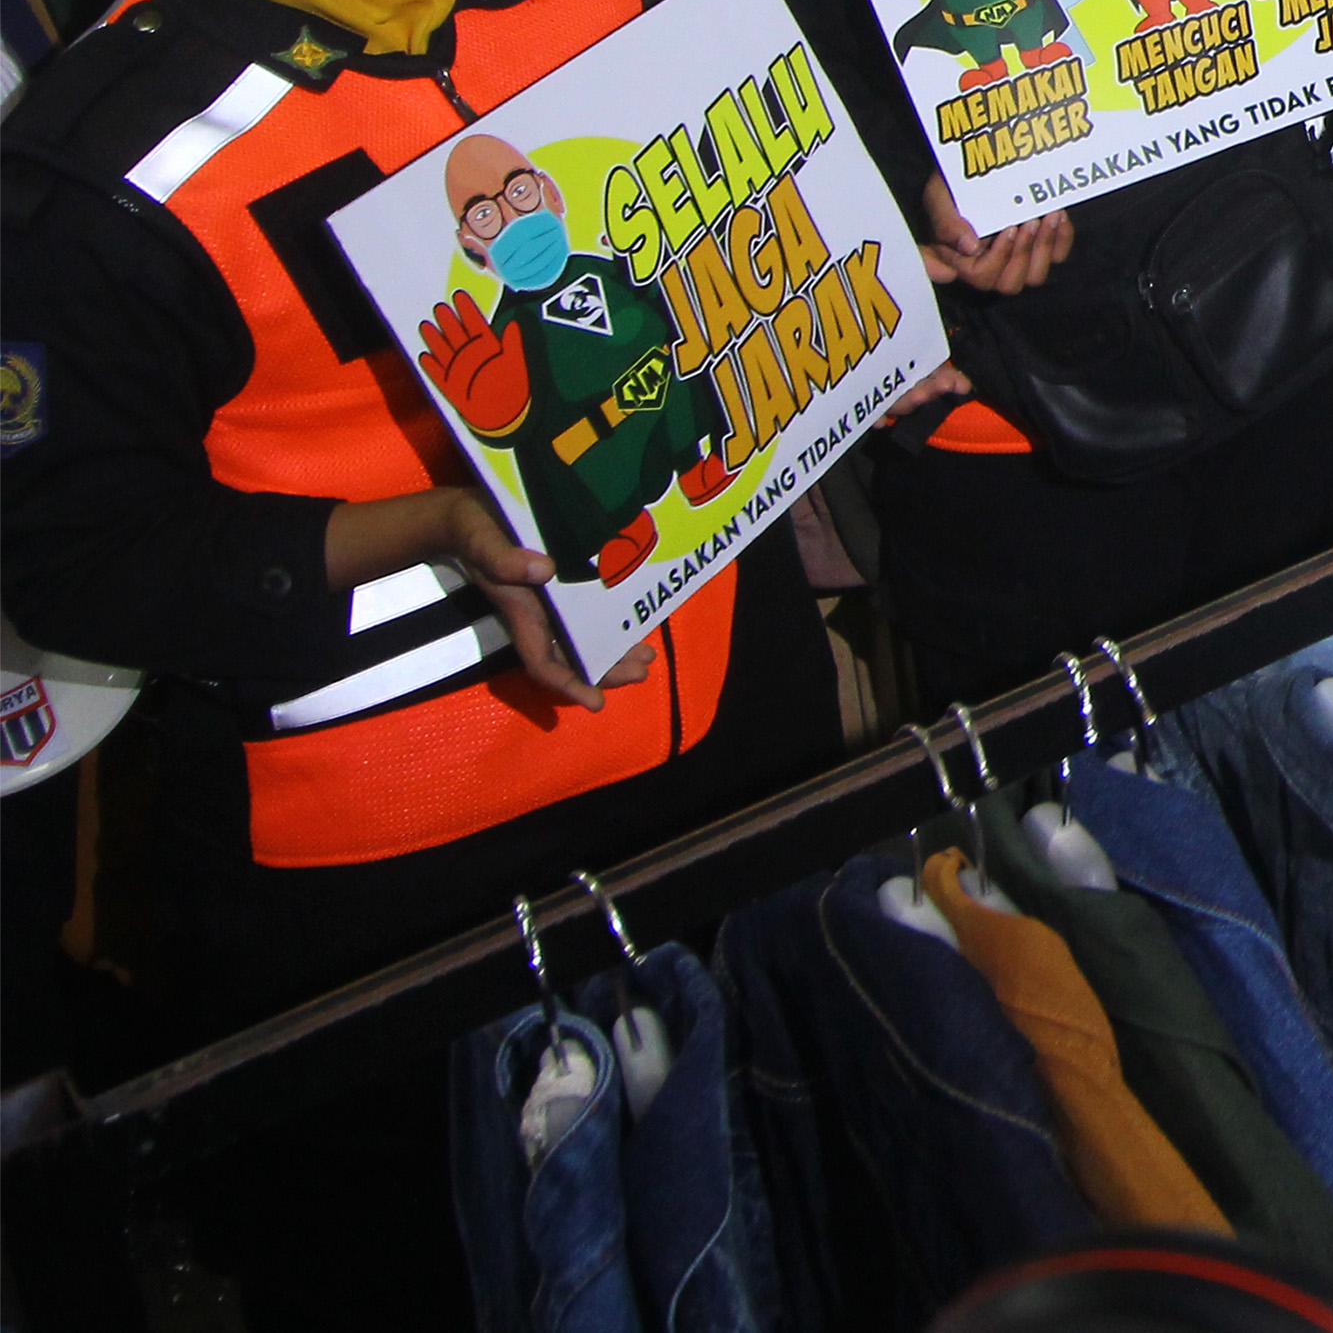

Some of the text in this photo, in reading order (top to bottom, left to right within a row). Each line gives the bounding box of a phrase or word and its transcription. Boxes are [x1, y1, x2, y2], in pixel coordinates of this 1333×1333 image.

[936, 57, 1088, 144] MEMAKAI
[1115, 1, 1251, 82] MENCUCI
[1138, 40, 1257, 115] TANGAN
[602, 40, 835, 285] SELALU
[963, 100, 1093, 178] MASKER
[1030, 139, 1163, 205] BIASAKAN
[1168, 113, 1240, 153] YANG
[1244, 81, 1321, 126] TIDAK
[657, 174, 831, 382] JAGA
[709, 240, 902, 472] JARAK
[633, 374, 906, 625] BIASAKAN YANG TIDAK BIASA
